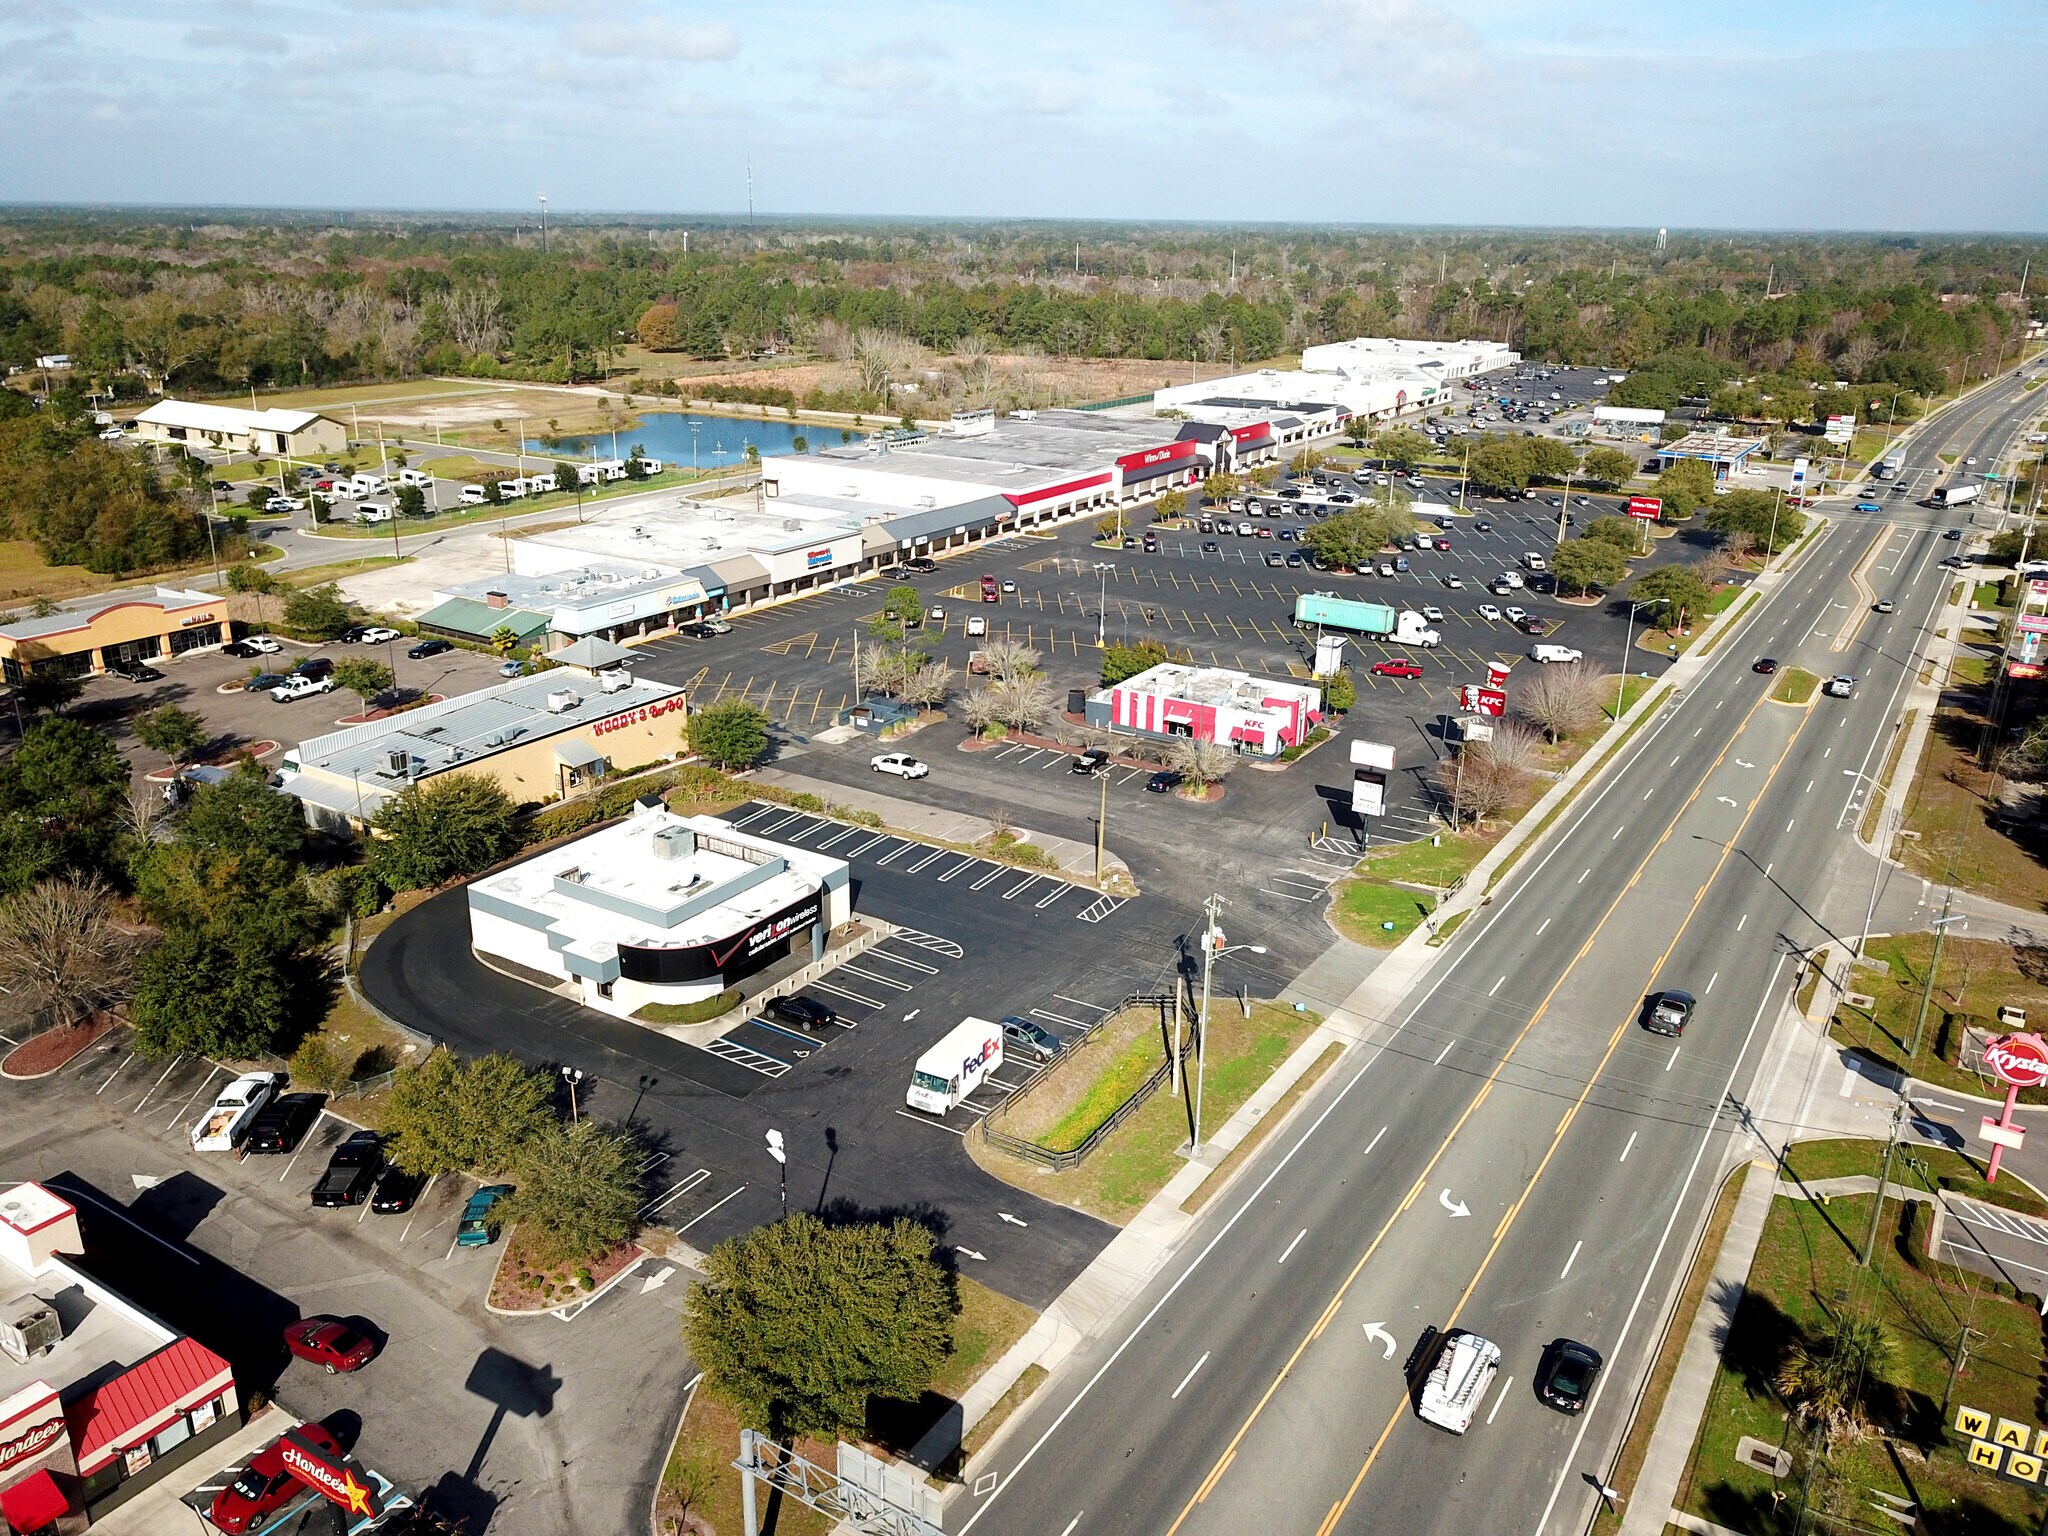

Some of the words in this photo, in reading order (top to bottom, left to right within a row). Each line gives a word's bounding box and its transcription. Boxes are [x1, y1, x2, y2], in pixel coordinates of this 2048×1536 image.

[1480, 696, 1504, 707] KFC
[593, 708, 648, 737] WOODY'S
[1244, 719, 1265, 730] KFC
[963, 1037, 1000, 1081] FedEx
[914, 1090, 934, 1100] FedEx
[282, 1448, 349, 1494] Hardee's
